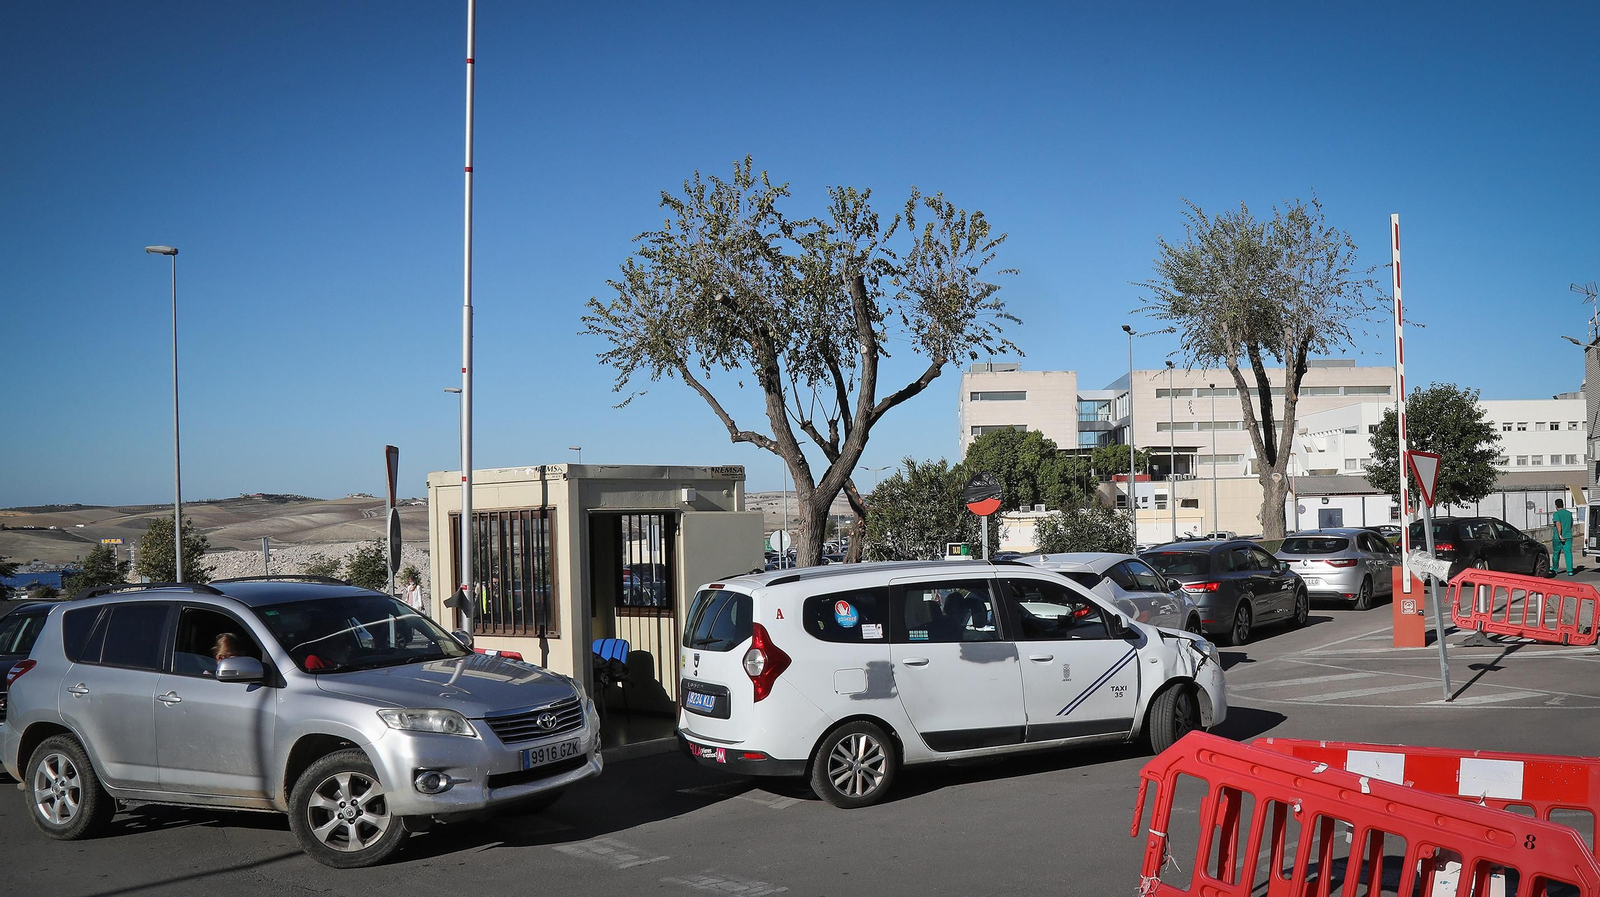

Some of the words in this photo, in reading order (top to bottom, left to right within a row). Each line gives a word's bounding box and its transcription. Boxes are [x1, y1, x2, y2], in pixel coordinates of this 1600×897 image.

[775, 608, 785, 620] A
[531, 746, 558, 764] 9916
[560, 741, 579, 757] GZK
[1523, 834, 1536, 850] 8
